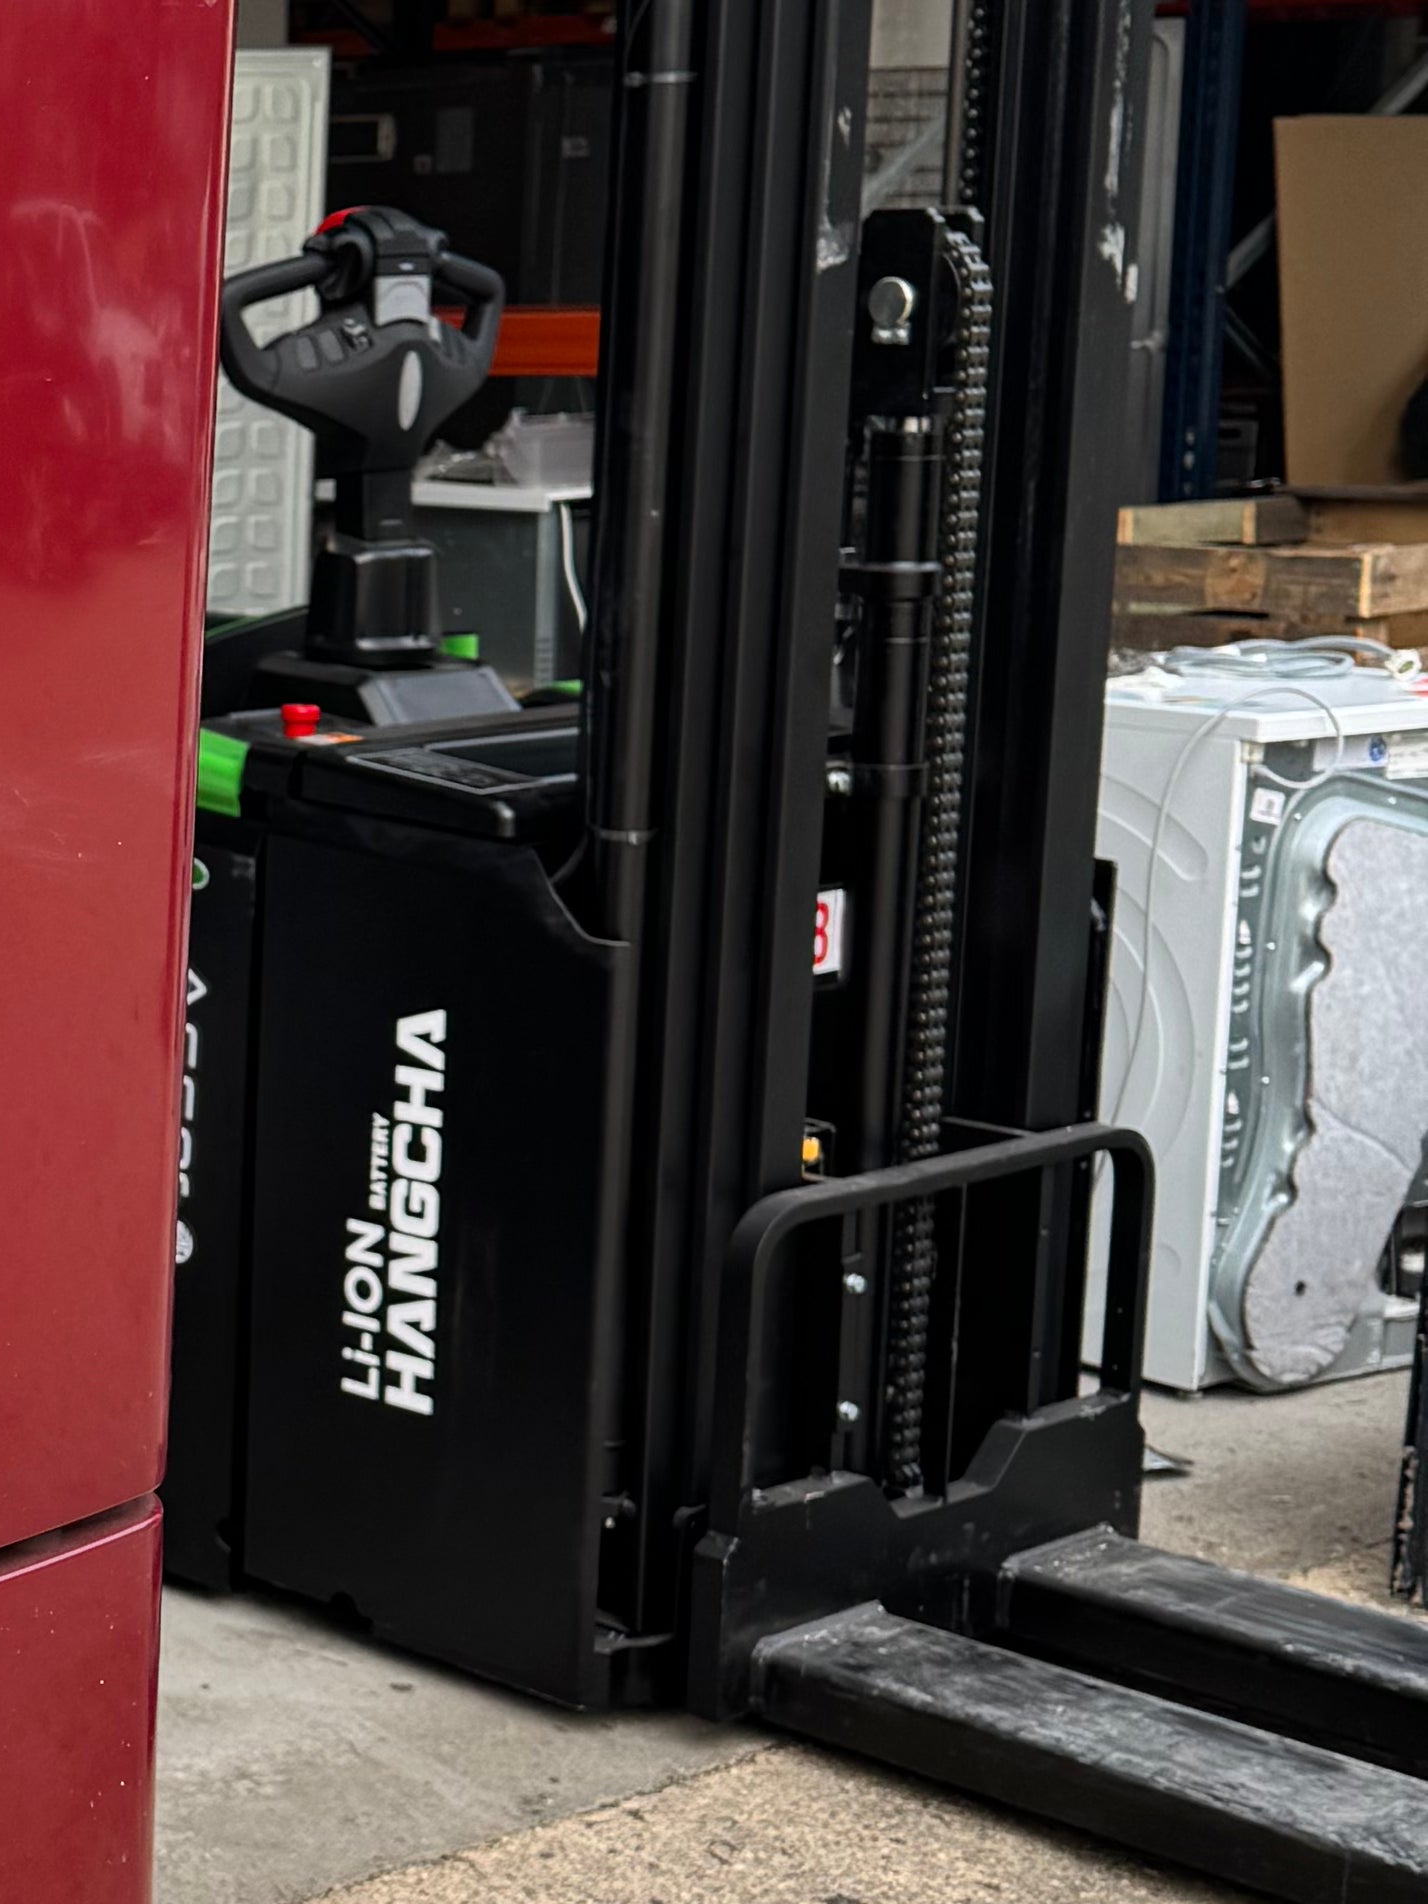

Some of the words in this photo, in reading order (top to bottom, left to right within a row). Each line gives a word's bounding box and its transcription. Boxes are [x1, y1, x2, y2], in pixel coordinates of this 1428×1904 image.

[341, 1217, 385, 1400] Li-ION
[368, 1111, 390, 1211] BATTERY
[384, 1008, 447, 1416] HANGCHA
